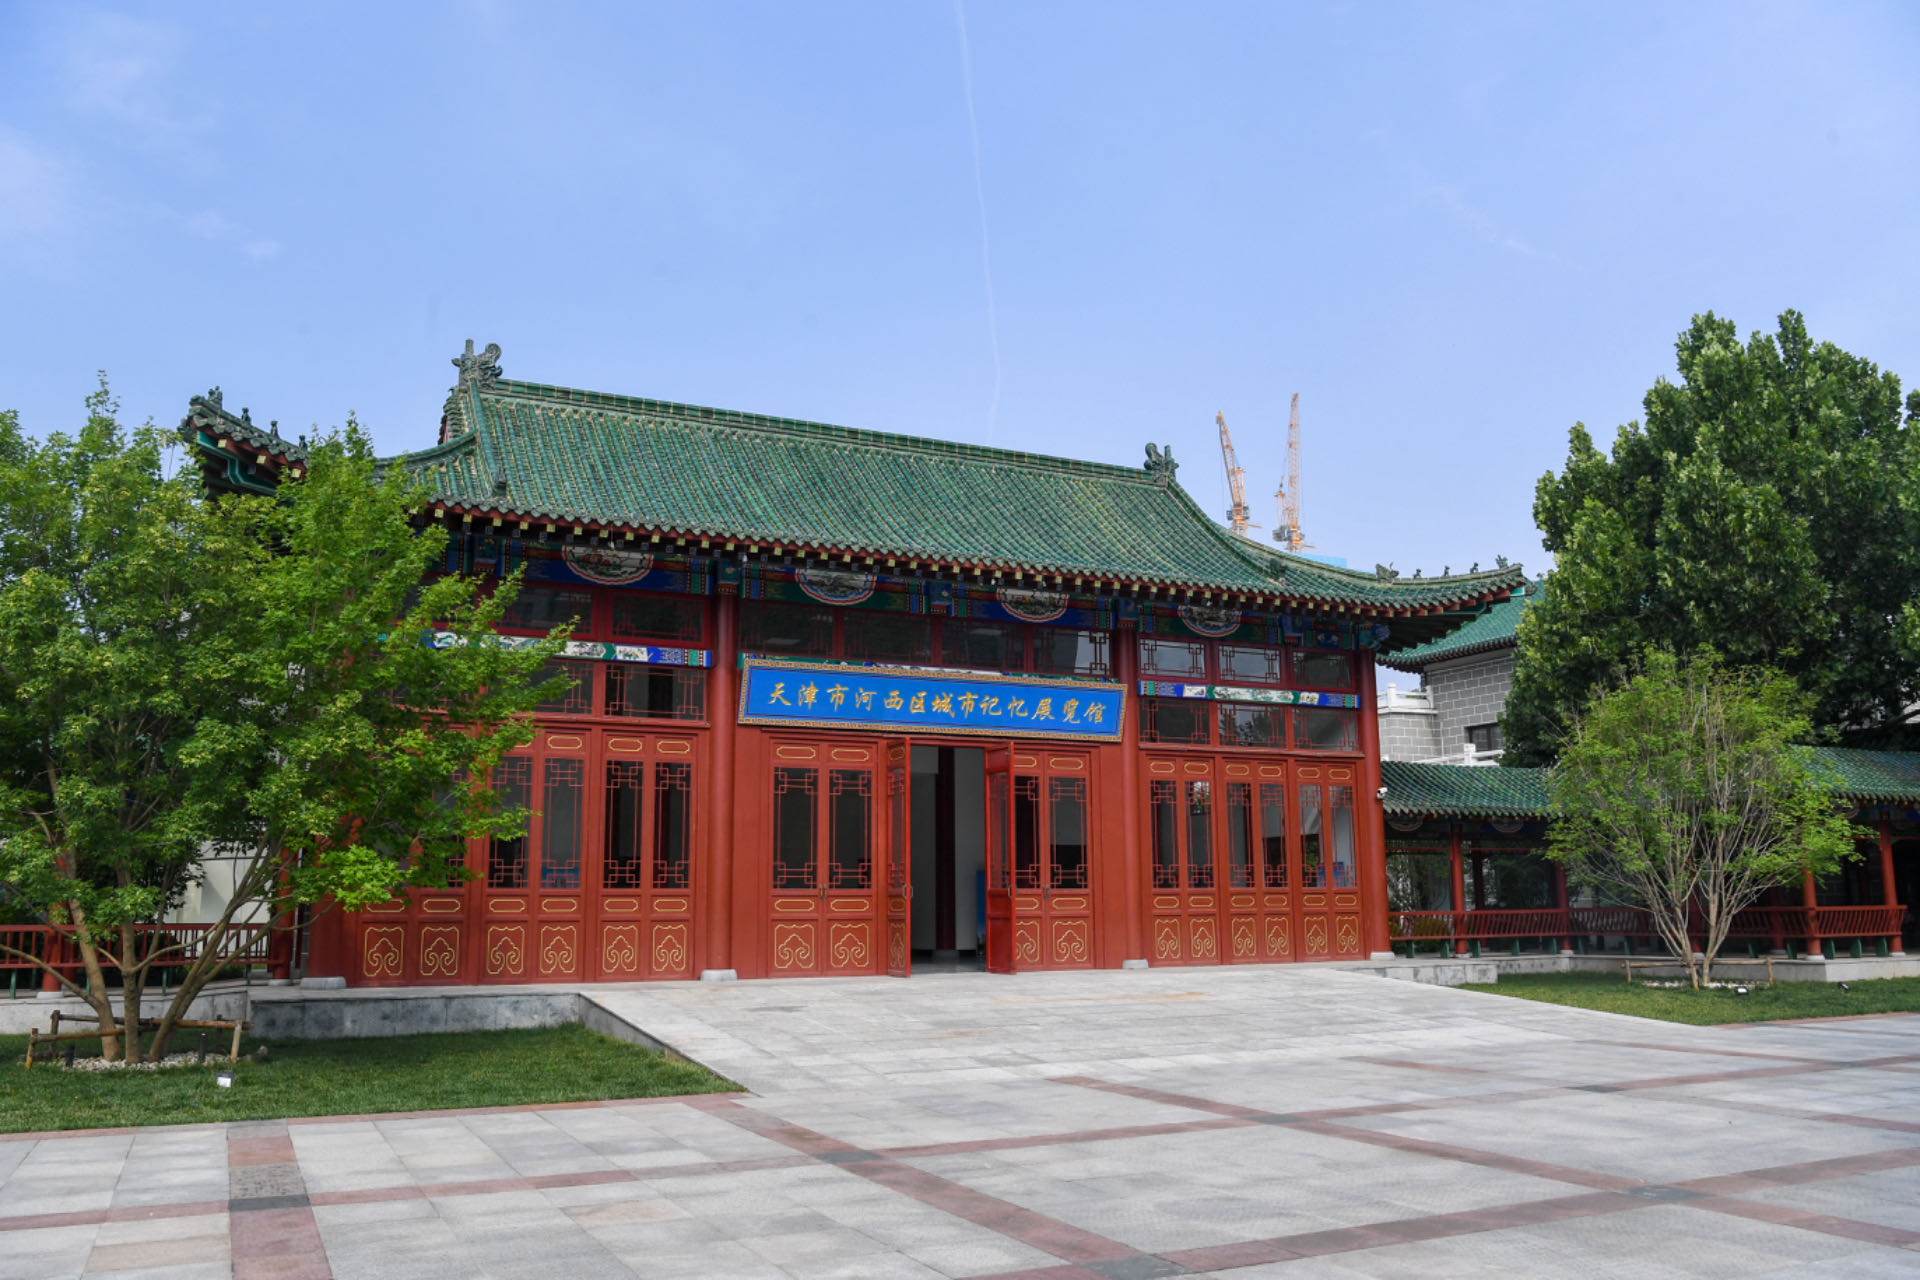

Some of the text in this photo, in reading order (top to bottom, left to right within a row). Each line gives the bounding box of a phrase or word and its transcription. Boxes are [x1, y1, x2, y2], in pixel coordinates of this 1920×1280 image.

[769, 681, 1106, 724] 天津市河西区城市记忆展览馆
